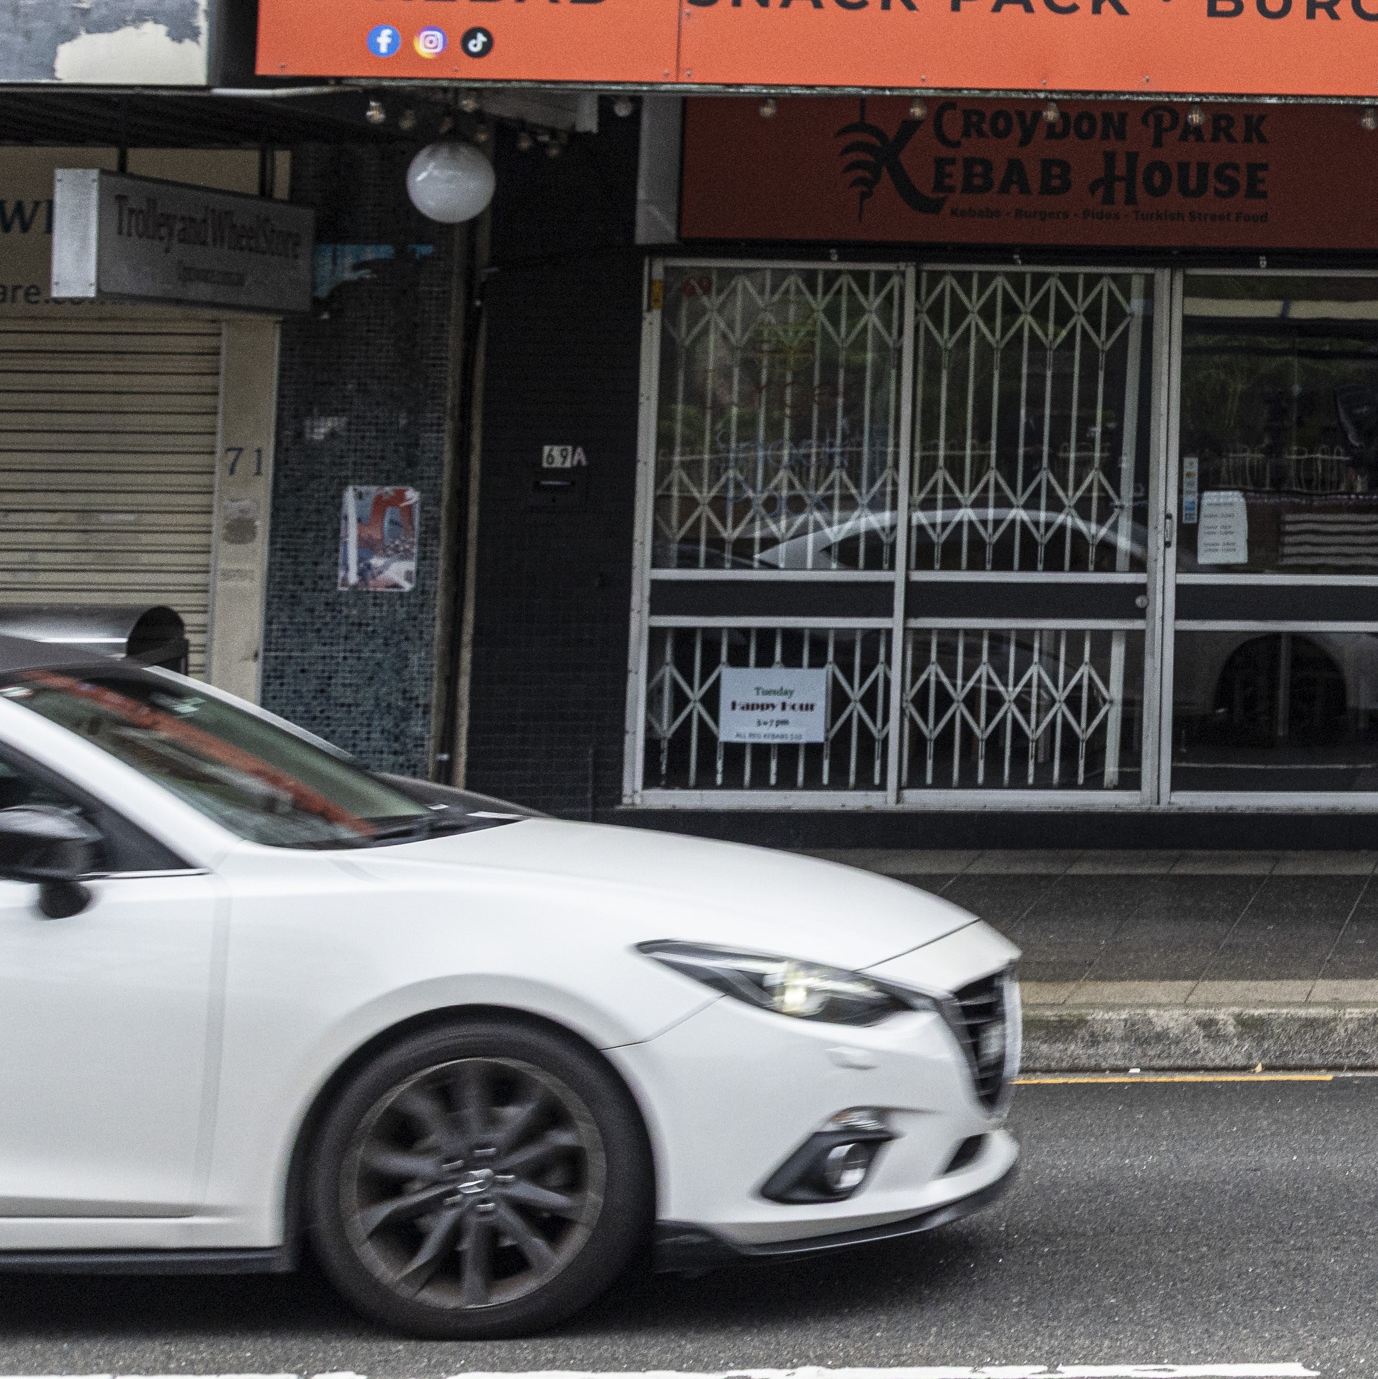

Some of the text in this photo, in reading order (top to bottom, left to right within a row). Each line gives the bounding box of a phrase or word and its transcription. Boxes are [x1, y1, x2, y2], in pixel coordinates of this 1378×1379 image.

[933, 101, 1270, 148] CROYDON PARK
[1089, 151, 1270, 206] HOUSE
[115, 194, 173, 254] Trolley
[1014, 209, 1070, 221] Burgers
[1133, 210, 1185, 222] Turkish
[1188, 212, 1232, 224] Street
[1235, 212, 1269, 224] Food
[225, 447, 264, 476] 71
[730, 701, 816, 713] Happy Hour
[754, 686, 795, 699] Tuesday
